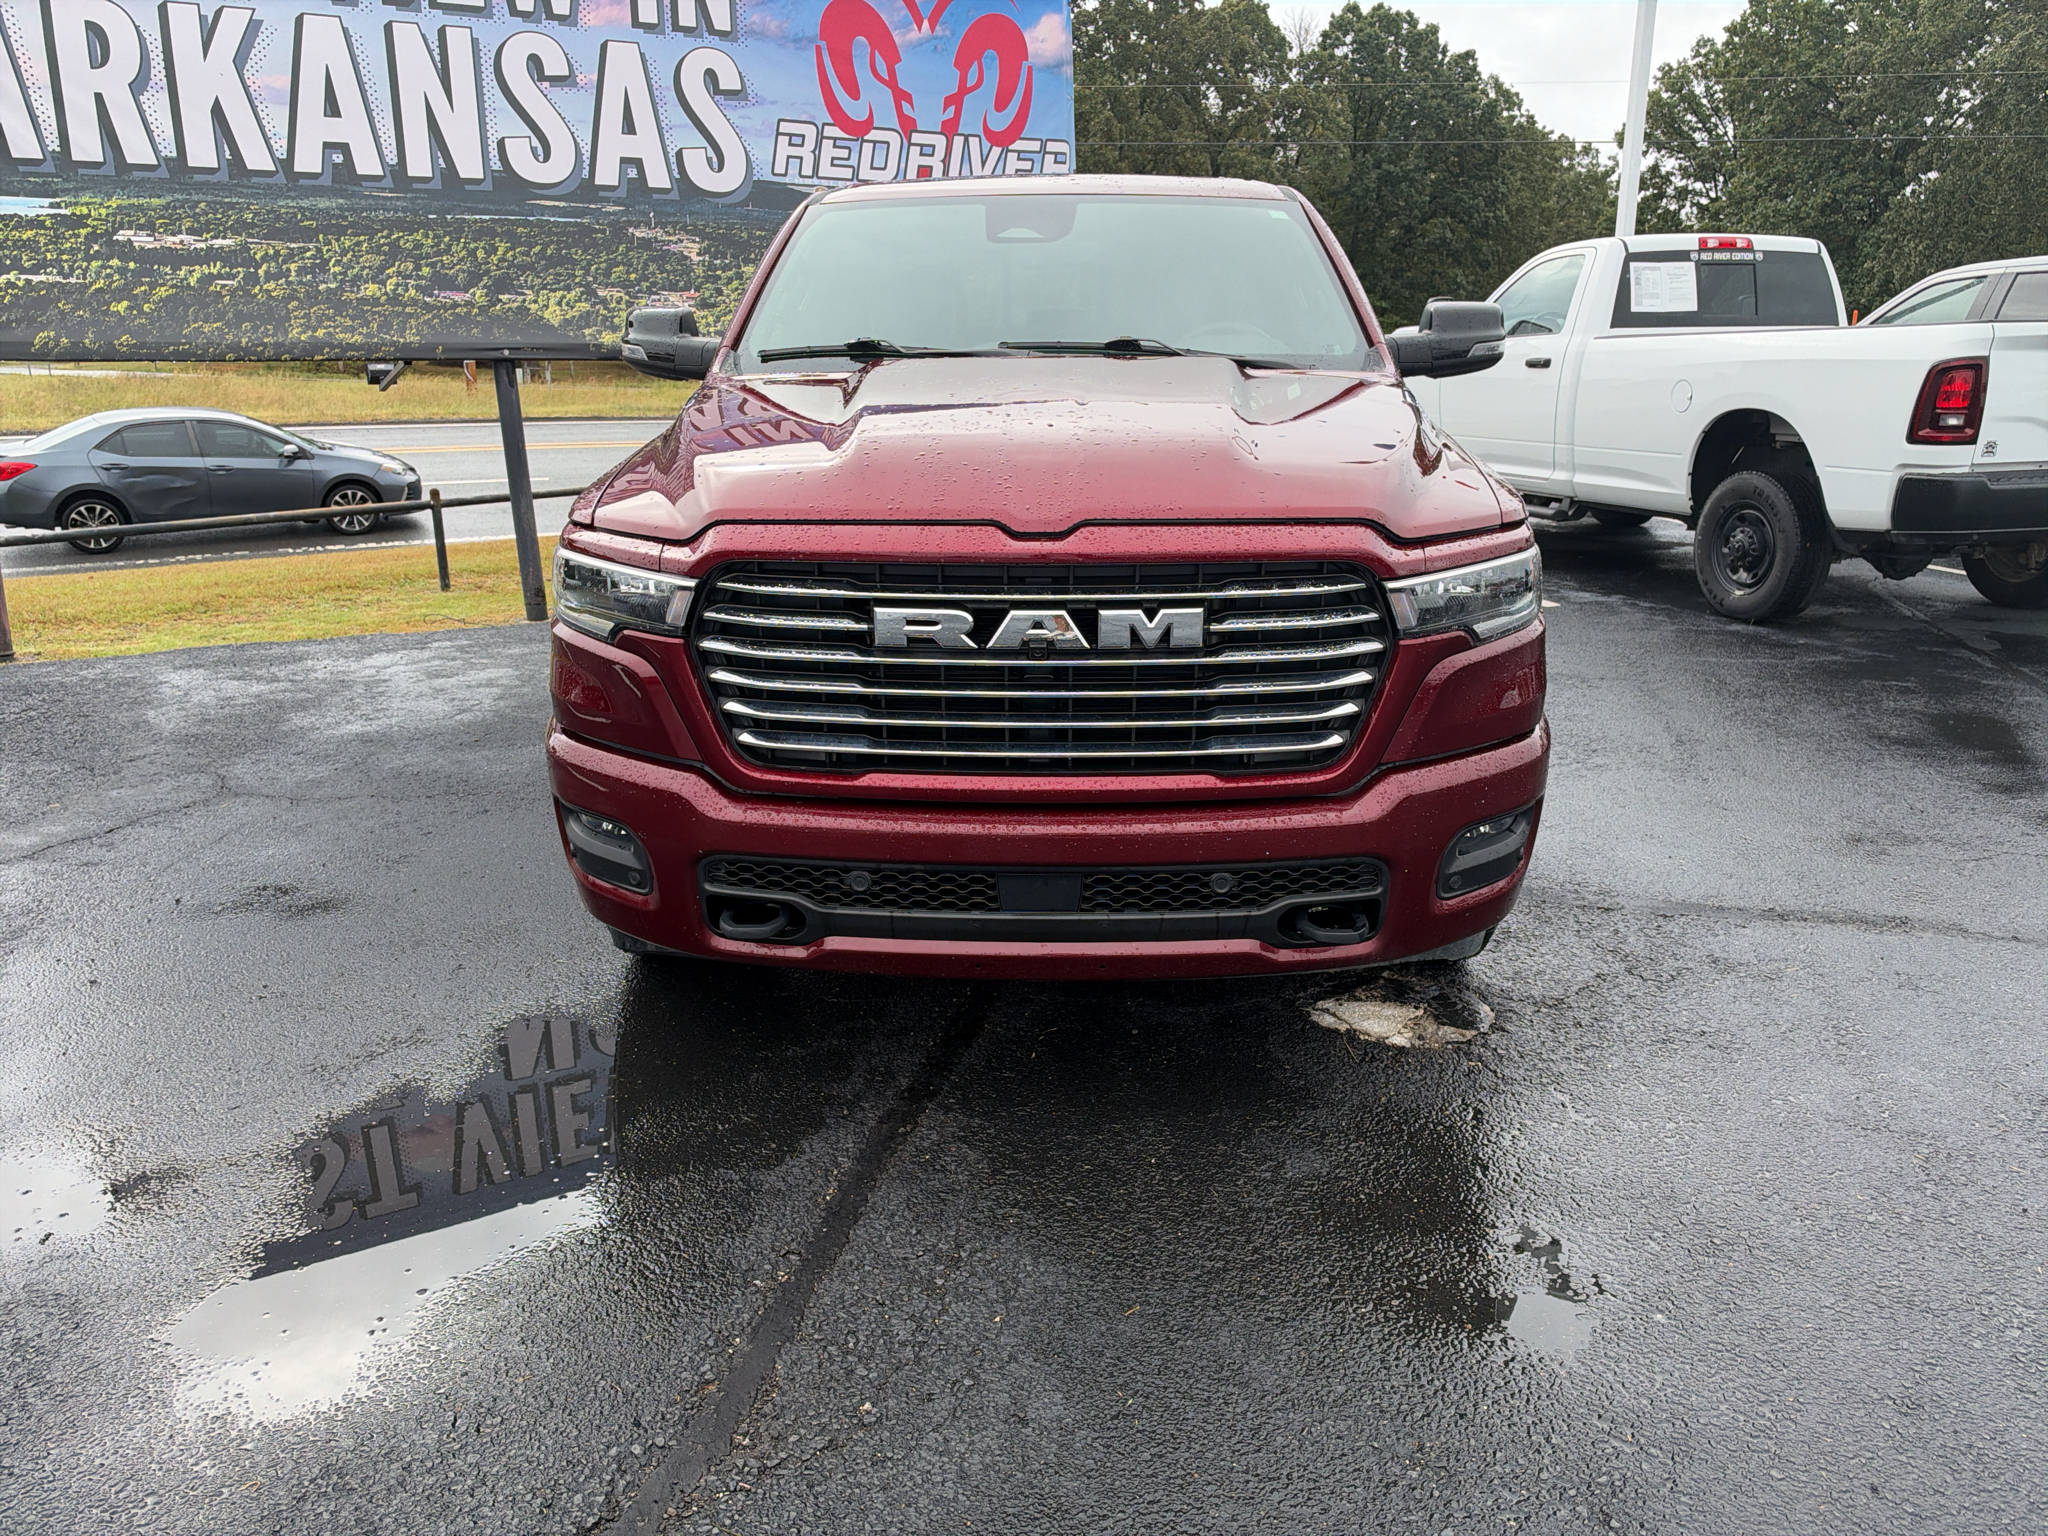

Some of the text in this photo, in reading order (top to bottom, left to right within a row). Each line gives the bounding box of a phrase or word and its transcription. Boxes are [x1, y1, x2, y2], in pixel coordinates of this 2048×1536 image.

[1700, 252, 1754, 261] RED RIVER EDITION
[873, 606, 1205, 650] RAM
